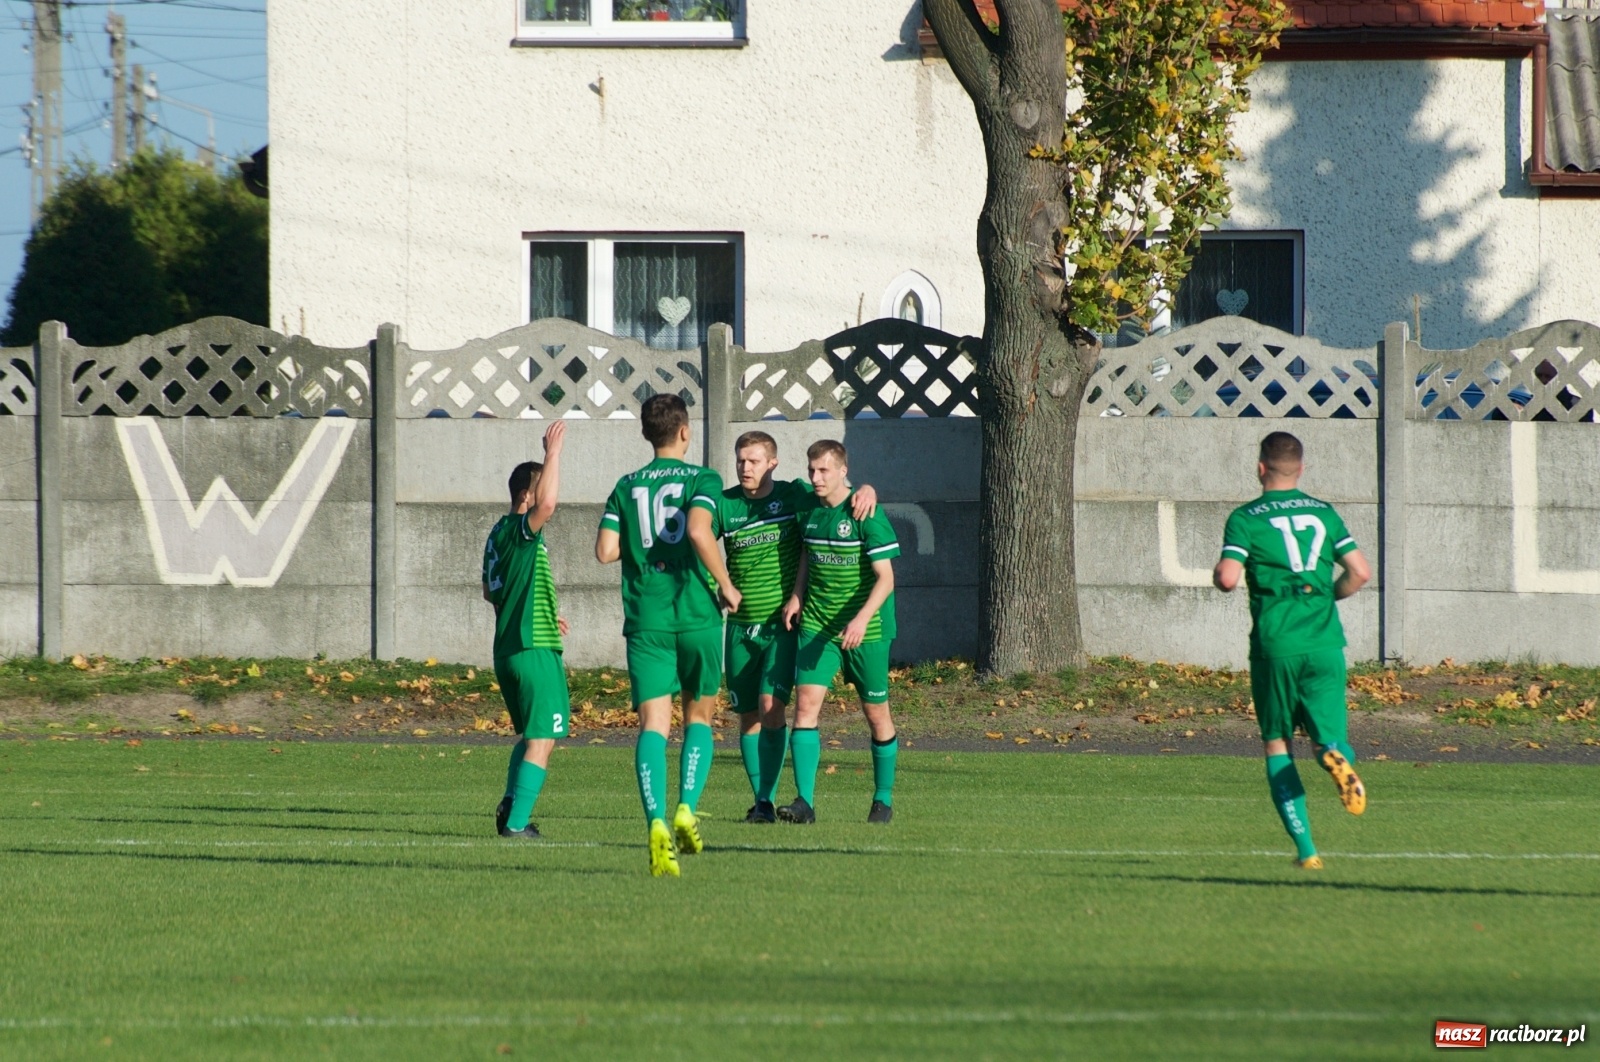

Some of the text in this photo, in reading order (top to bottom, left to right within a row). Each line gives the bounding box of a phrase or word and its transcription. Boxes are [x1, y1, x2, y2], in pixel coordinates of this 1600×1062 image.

[114, 416, 357, 587] W
[631, 483, 686, 549] 16
[1269, 514, 1327, 573] 17
[553, 713, 564, 733] 2
